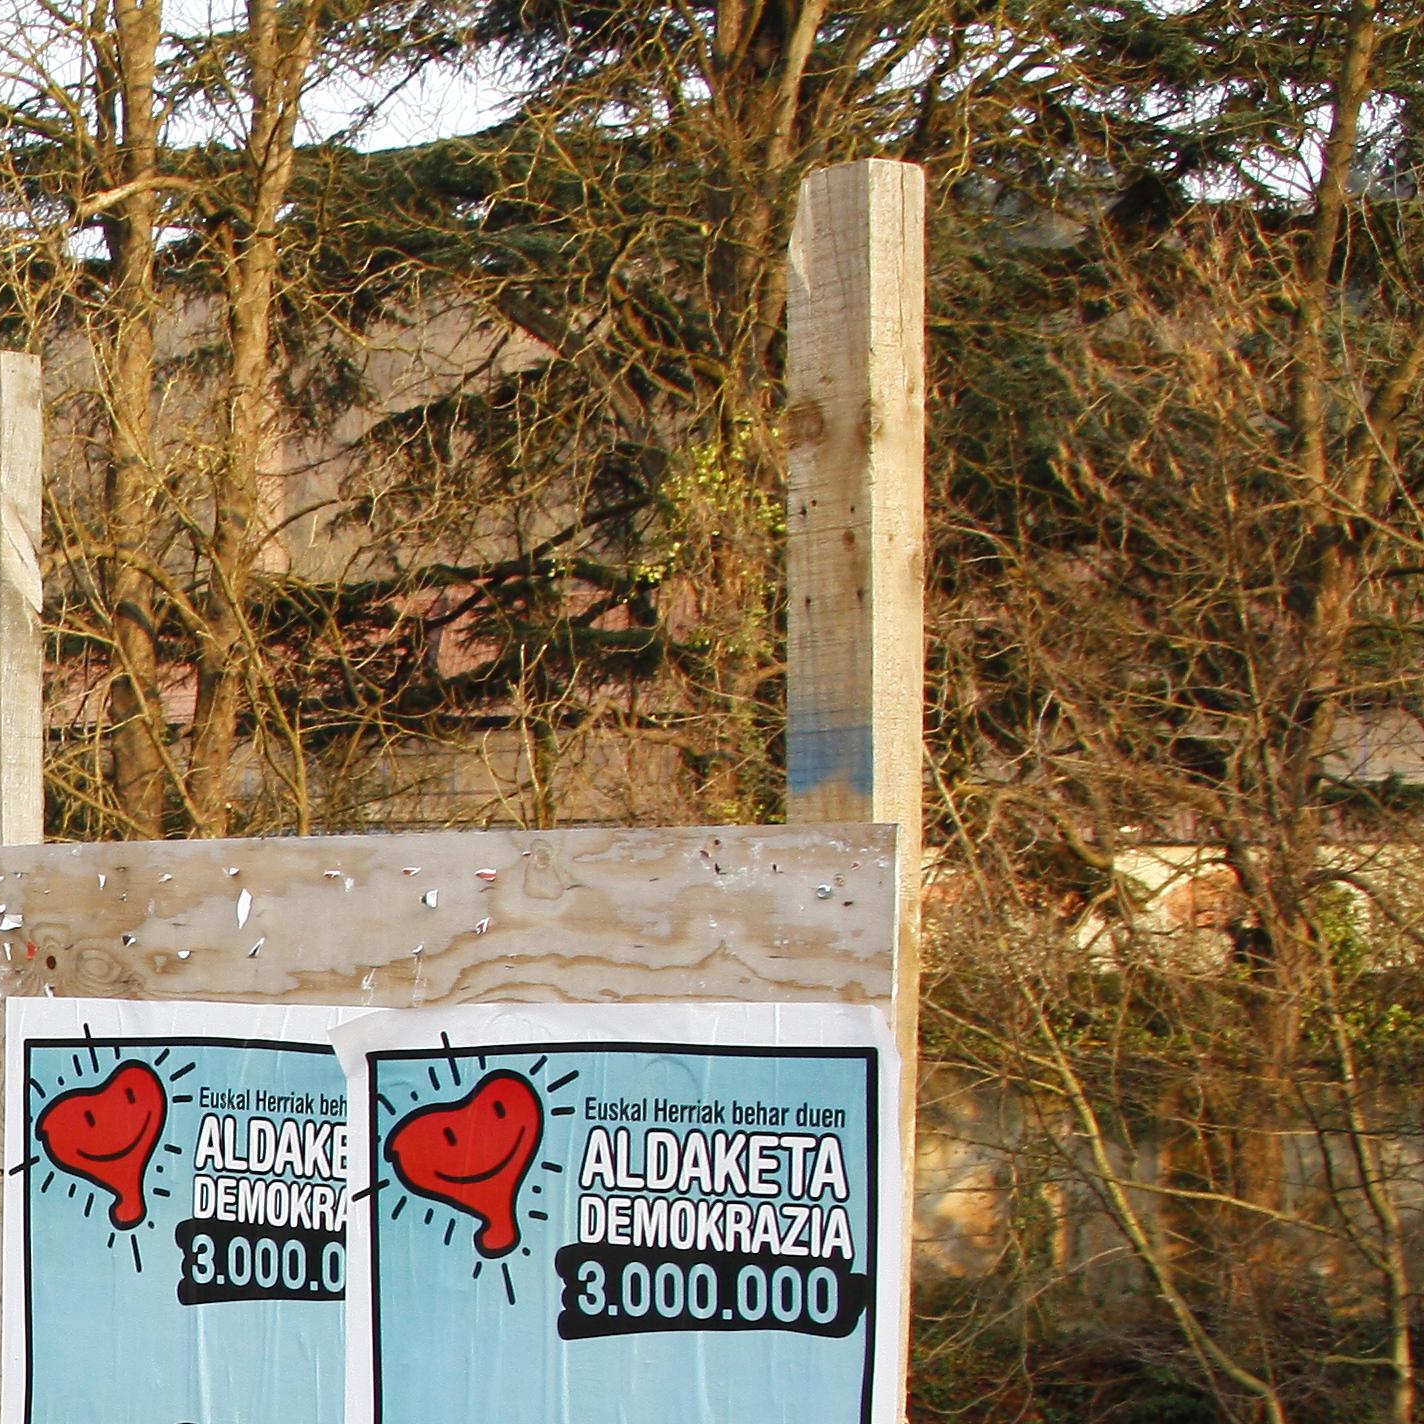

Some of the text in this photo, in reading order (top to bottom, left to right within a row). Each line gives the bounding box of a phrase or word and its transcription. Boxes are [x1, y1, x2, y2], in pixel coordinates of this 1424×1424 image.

[199, 1087, 250, 1112] Euskal
[255, 1090, 315, 1115] Herriak
[585, 1096, 846, 1128] Euskal Herriak behar duen
[580, 1128, 849, 1200] ALDAKETA
[579, 1197, 852, 1260] DEMOKRAZIA
[191, 1234, 347, 1293] 3.000.0
[577, 1261, 839, 1324] 3.000.000
